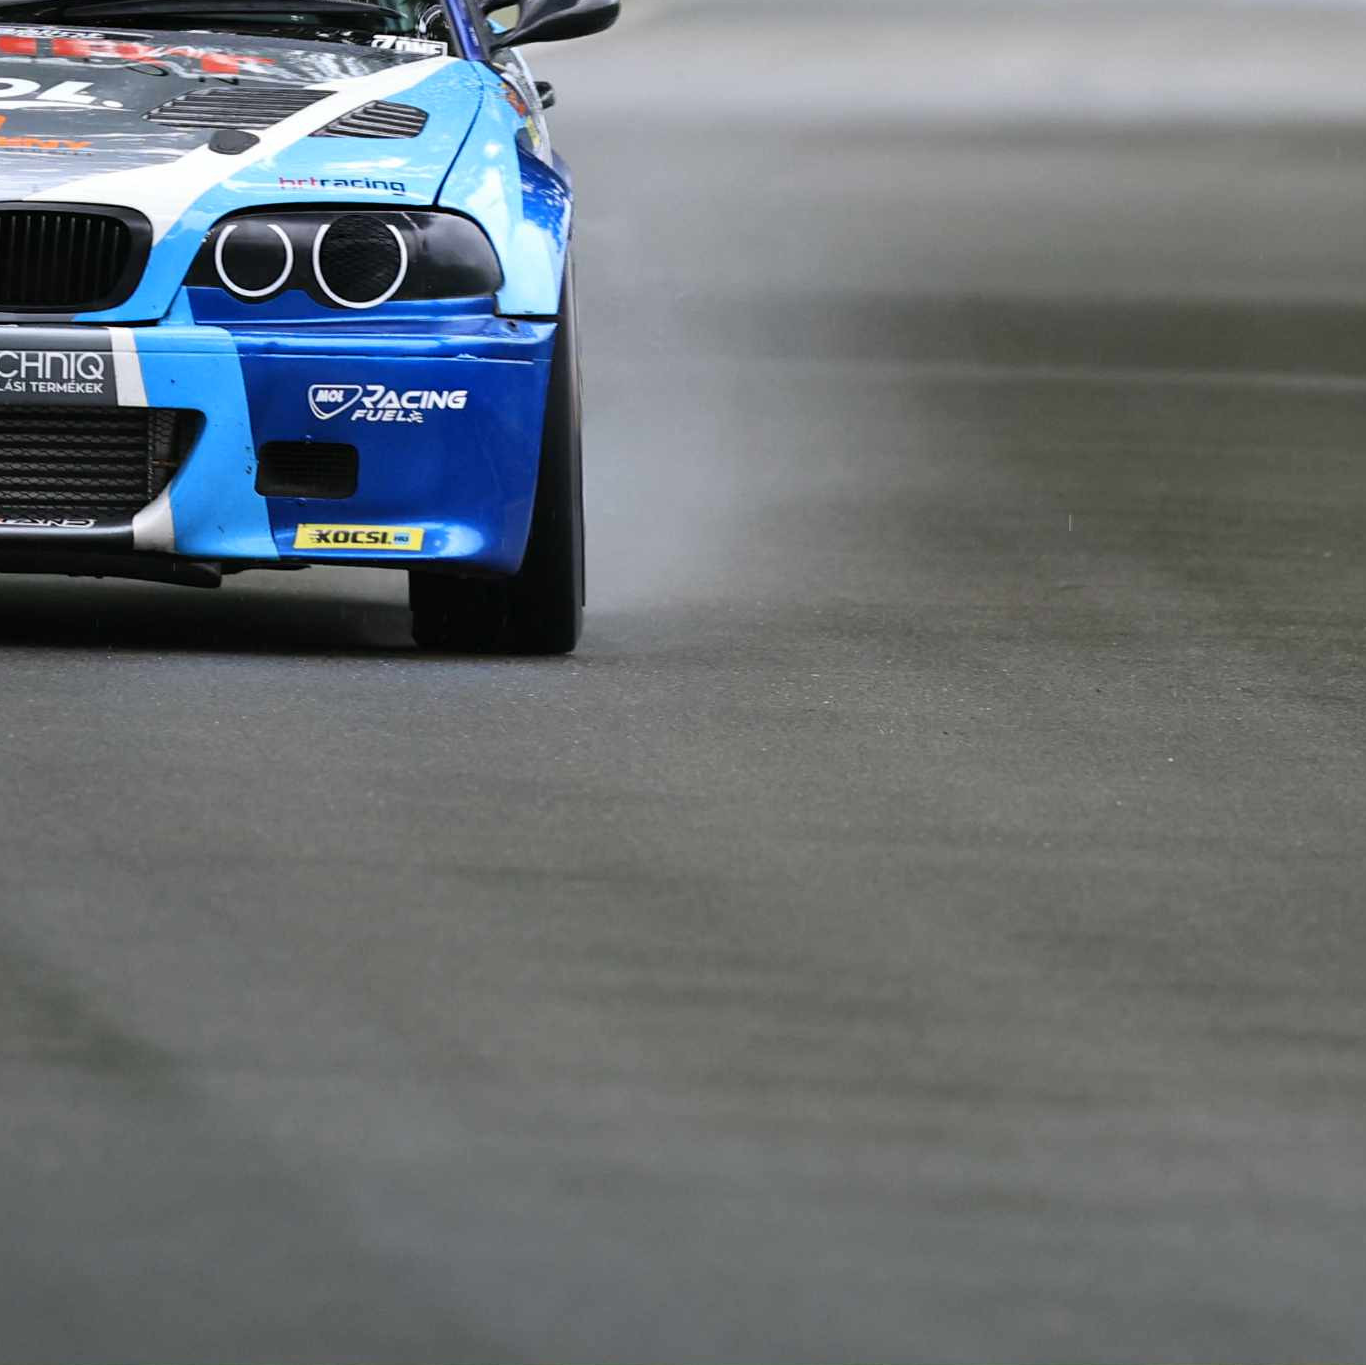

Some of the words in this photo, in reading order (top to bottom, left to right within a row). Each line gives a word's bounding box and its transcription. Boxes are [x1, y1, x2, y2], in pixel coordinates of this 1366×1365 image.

[30, 379, 104, 394] TERMÉKEK
[361, 384, 468, 409] RACING
[350, 410, 409, 423] FUEL
